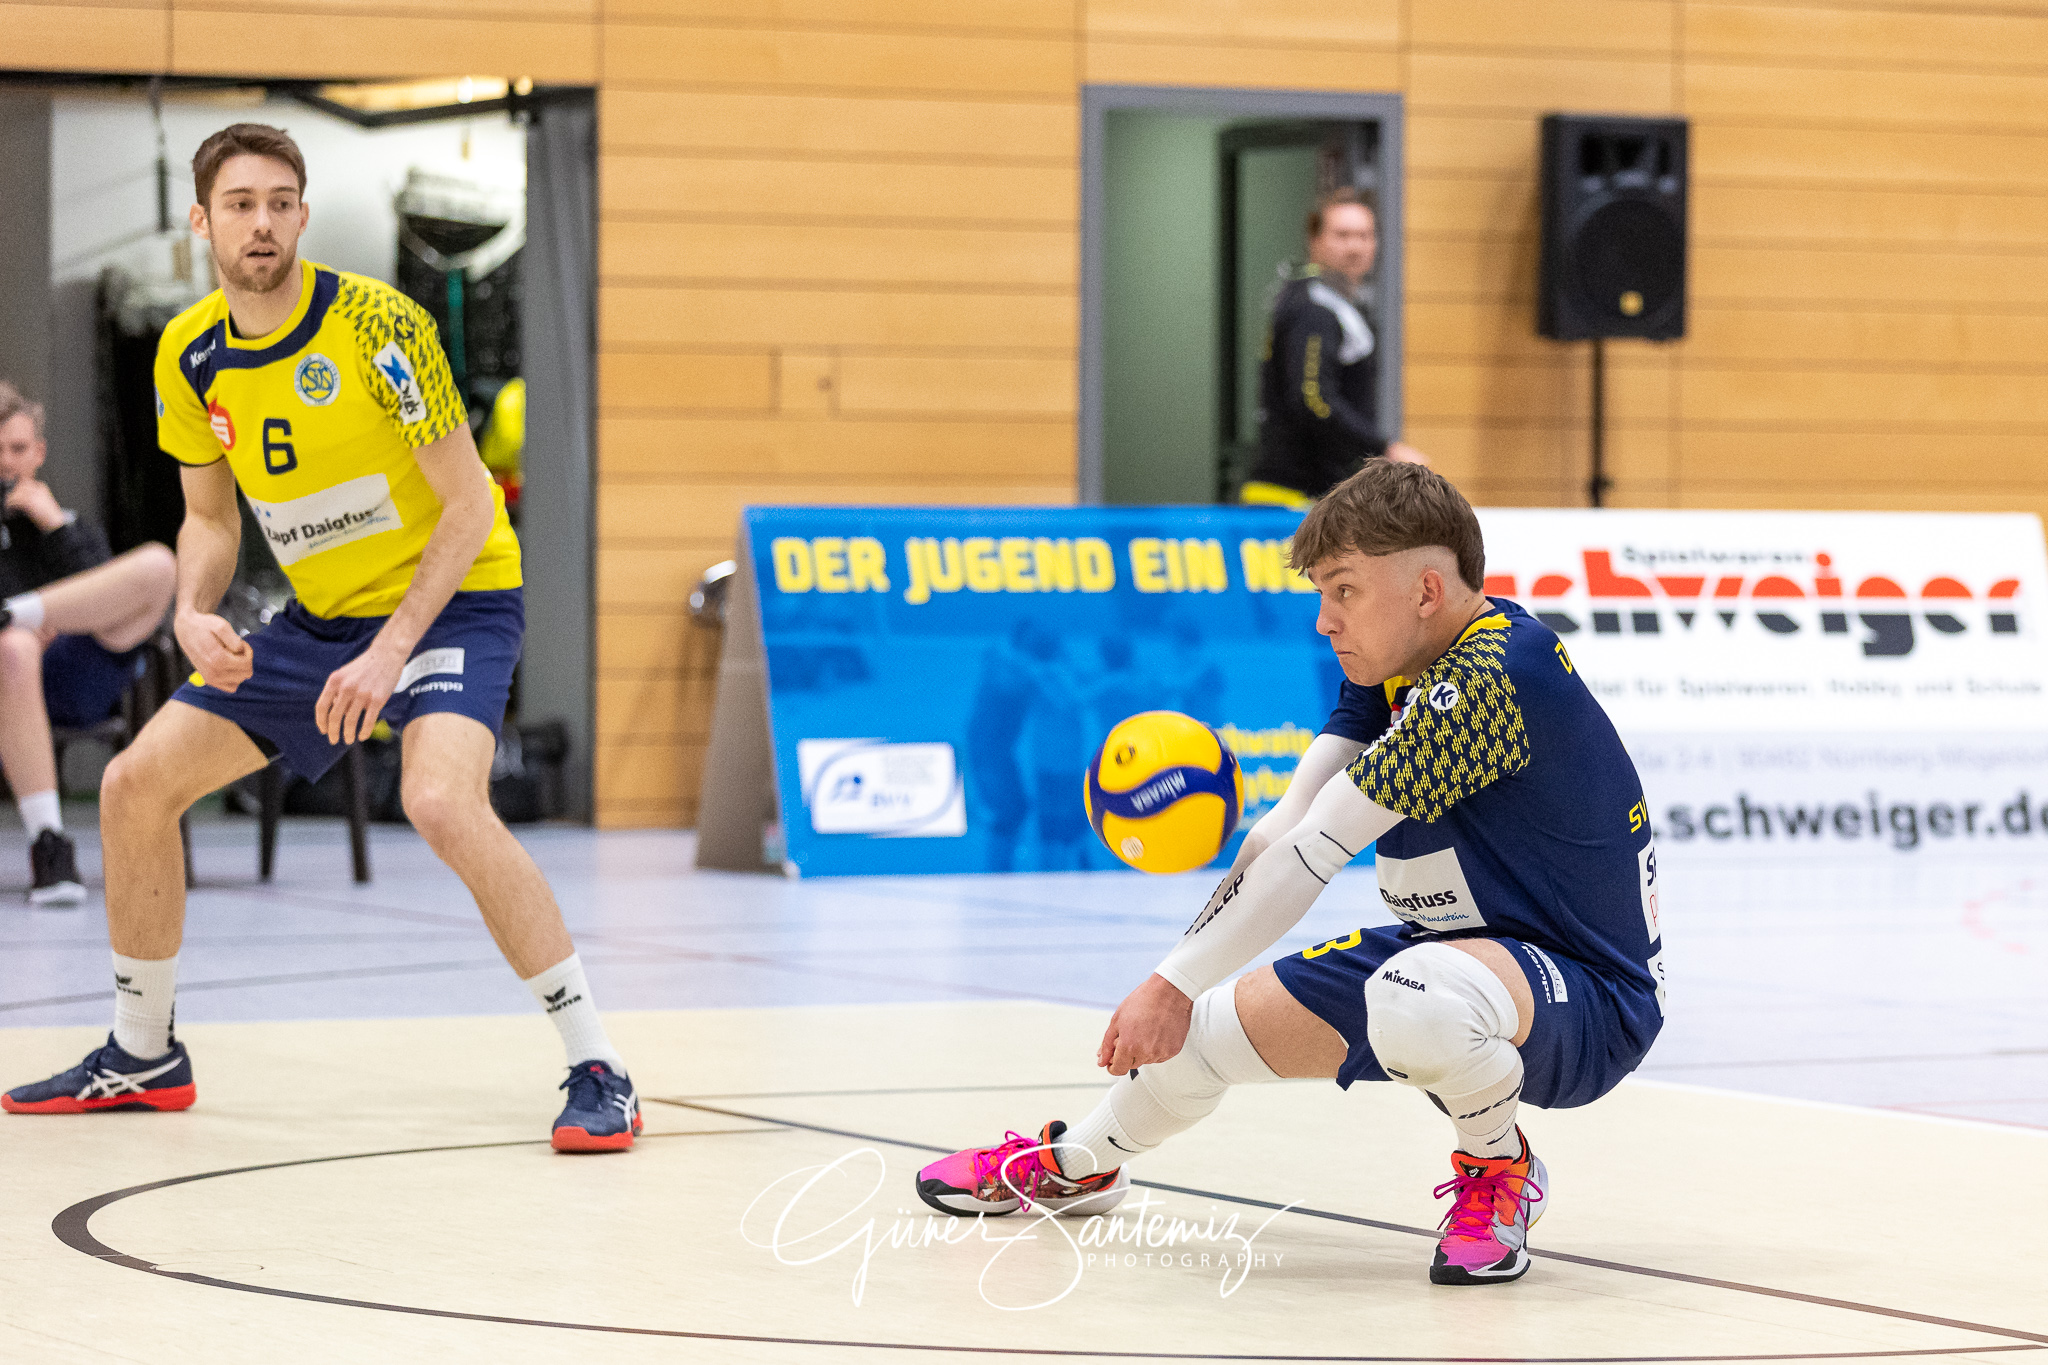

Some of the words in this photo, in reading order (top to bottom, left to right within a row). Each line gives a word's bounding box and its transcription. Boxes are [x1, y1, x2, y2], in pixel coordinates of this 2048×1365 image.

[262, 417, 298, 475] 6
[771, 537, 890, 593] DER
[904, 538, 1116, 604] JUGEND
[1129, 538, 1228, 594] EIN
[1379, 888, 1458, 912] Daigfuss
[1382, 969, 1426, 992] MIKASA
